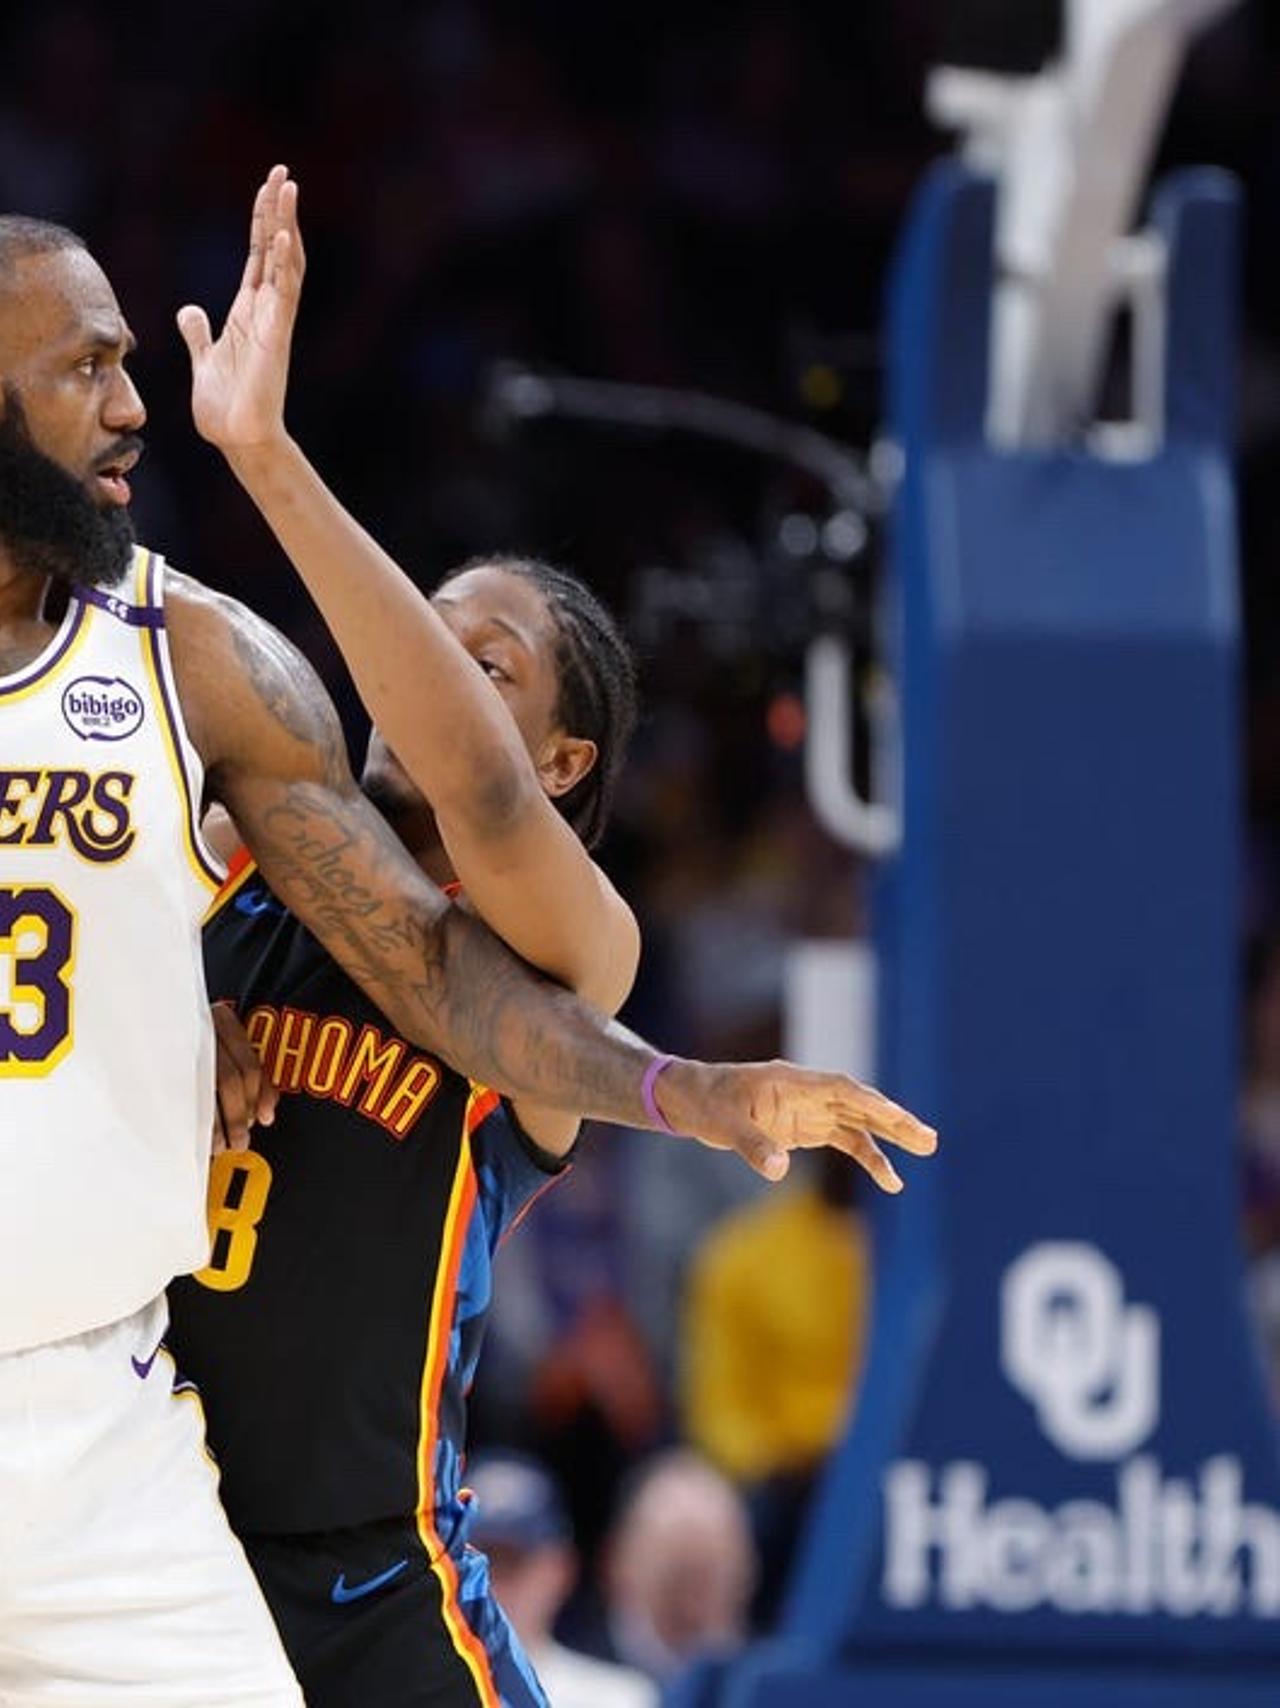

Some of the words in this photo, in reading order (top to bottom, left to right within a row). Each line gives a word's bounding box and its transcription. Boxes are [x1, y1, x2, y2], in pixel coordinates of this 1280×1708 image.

[69, 691, 138, 723] bibigo
[246, 1003, 444, 1141] AHOMA
[1001, 1238, 1160, 1462] OU
[882, 1453, 1280, 1618] Health
